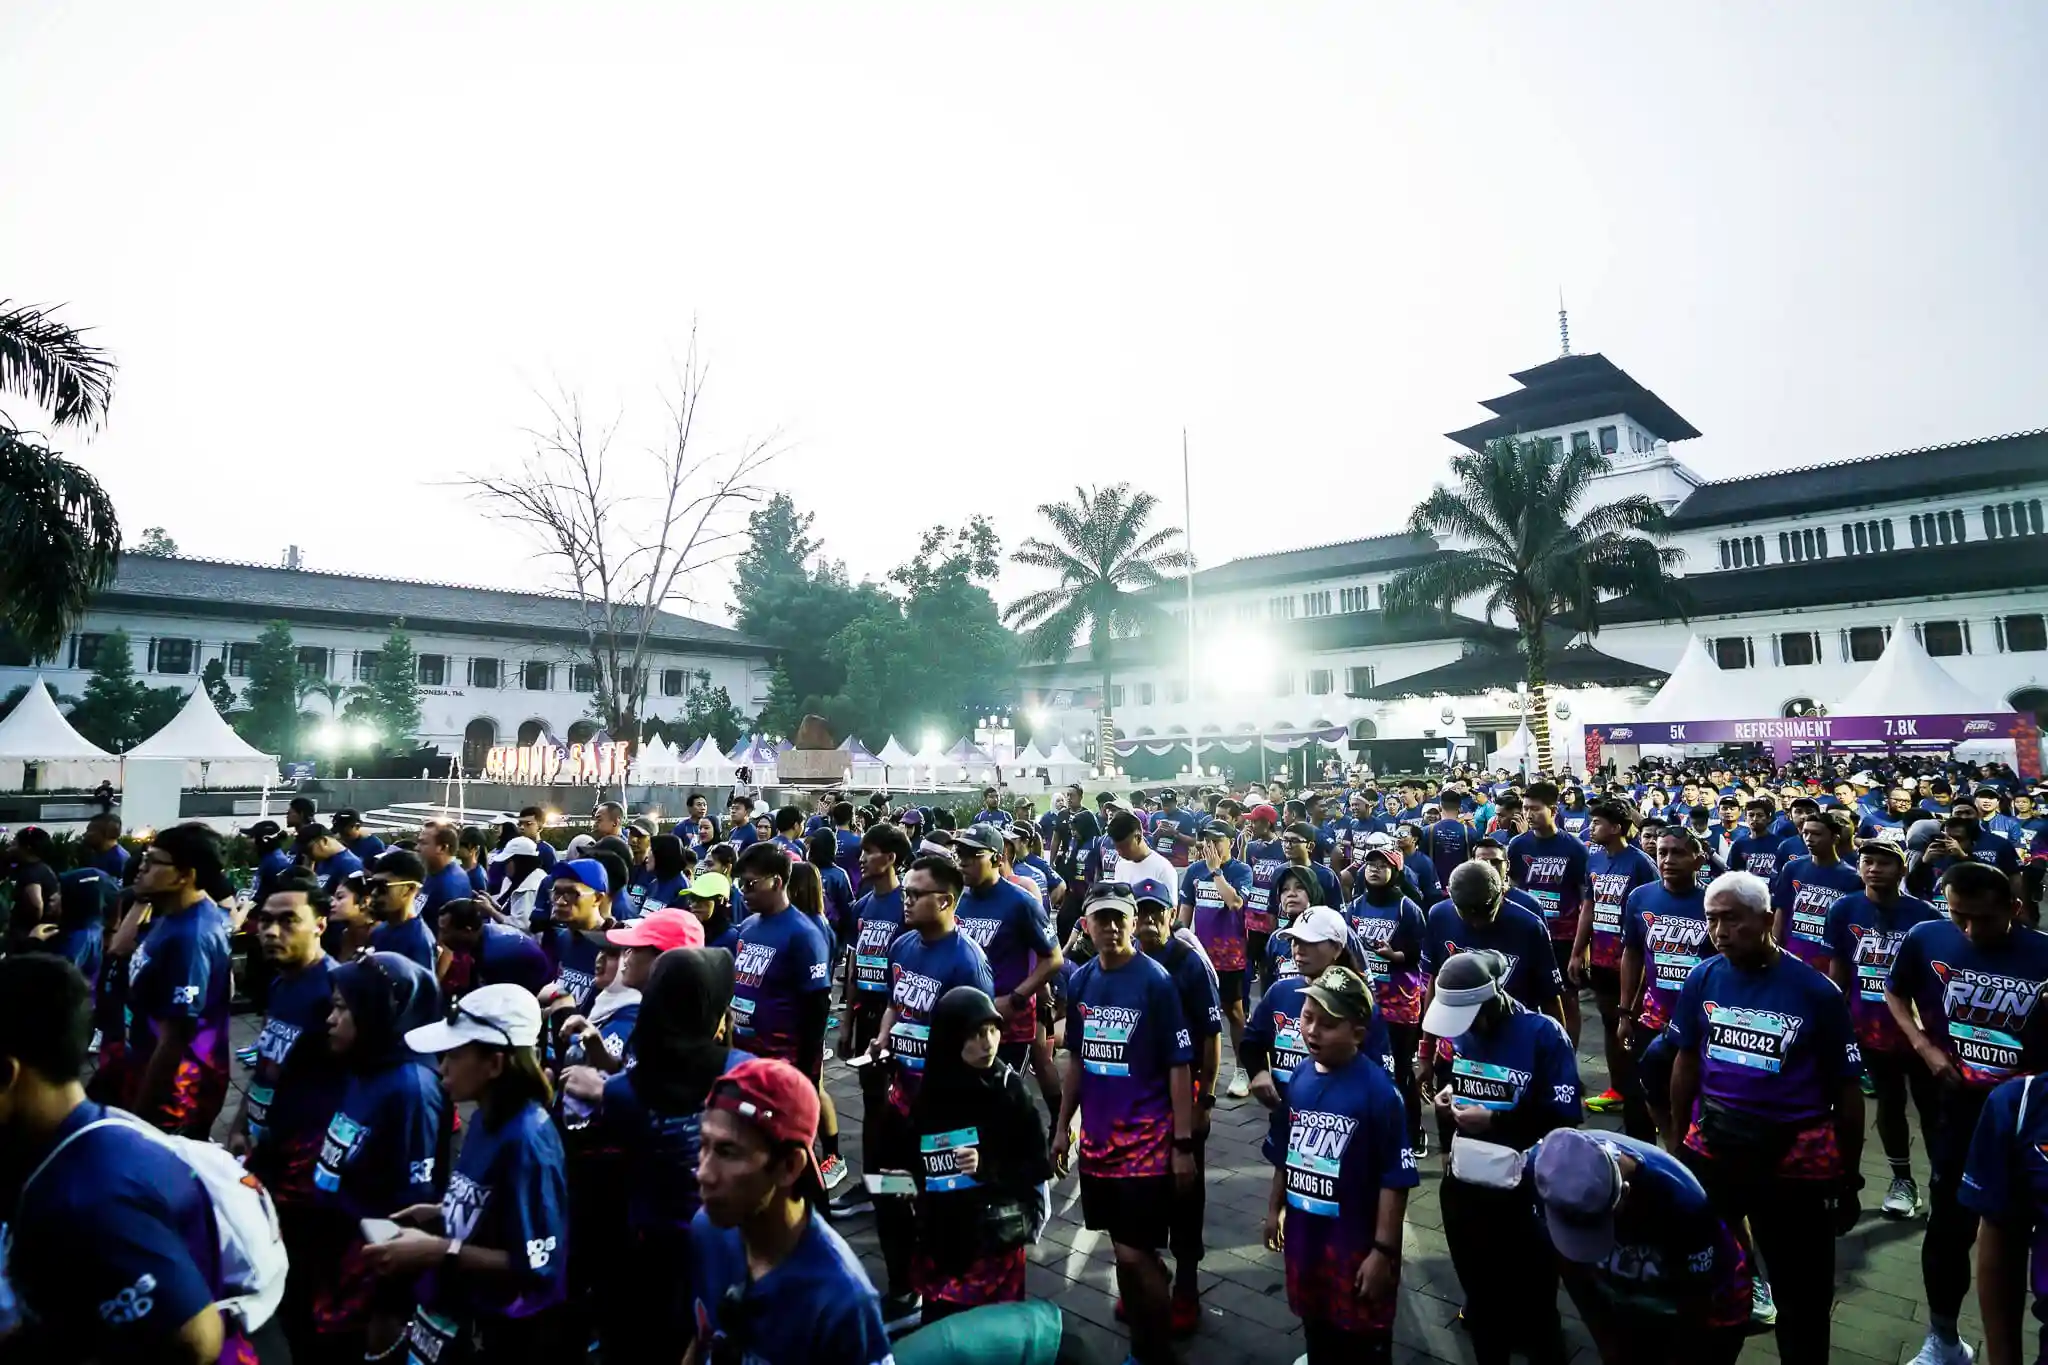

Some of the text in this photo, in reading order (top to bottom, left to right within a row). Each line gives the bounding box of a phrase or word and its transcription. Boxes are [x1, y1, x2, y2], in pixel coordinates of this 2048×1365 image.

[1670, 725, 1686, 739] 5K
[1734, 720, 1832, 738] REFRESHMENT
[1883, 719, 1918, 736] 7.8K
[1537, 857, 1568, 865] POSPAY
[1527, 863, 1566, 882] RUN
[1593, 881, 1626, 901] RUN
[965, 920, 1000, 930] POSPAY
[1357, 925, 1395, 941] RUN
[1662, 916, 1708, 931] POSPAY
[856, 929, 893, 955] RUN
[1647, 923, 1706, 949] RUN
[746, 943, 776, 960] POSPAY
[734, 953, 770, 976] RUN
[905, 973, 939, 993] POSPAY
[1964, 971, 2041, 995] POSPAY
[893, 981, 936, 1013] RUN
[1944, 981, 2036, 1018] RUN
[1094, 1008, 1139, 1023] POSPAY
[1713, 1026, 1775, 1053] 7.8K0242
[1275, 1051, 1302, 1067] 7.8K0
[1955, 1040, 2018, 1066] 7.8K0700
[1553, 1084, 1575, 1096] POS
[1300, 1112, 1356, 1133] POSPAY
[1289, 1126, 1350, 1159] RUN
[1287, 1168, 1334, 1197] 7.8K0516
